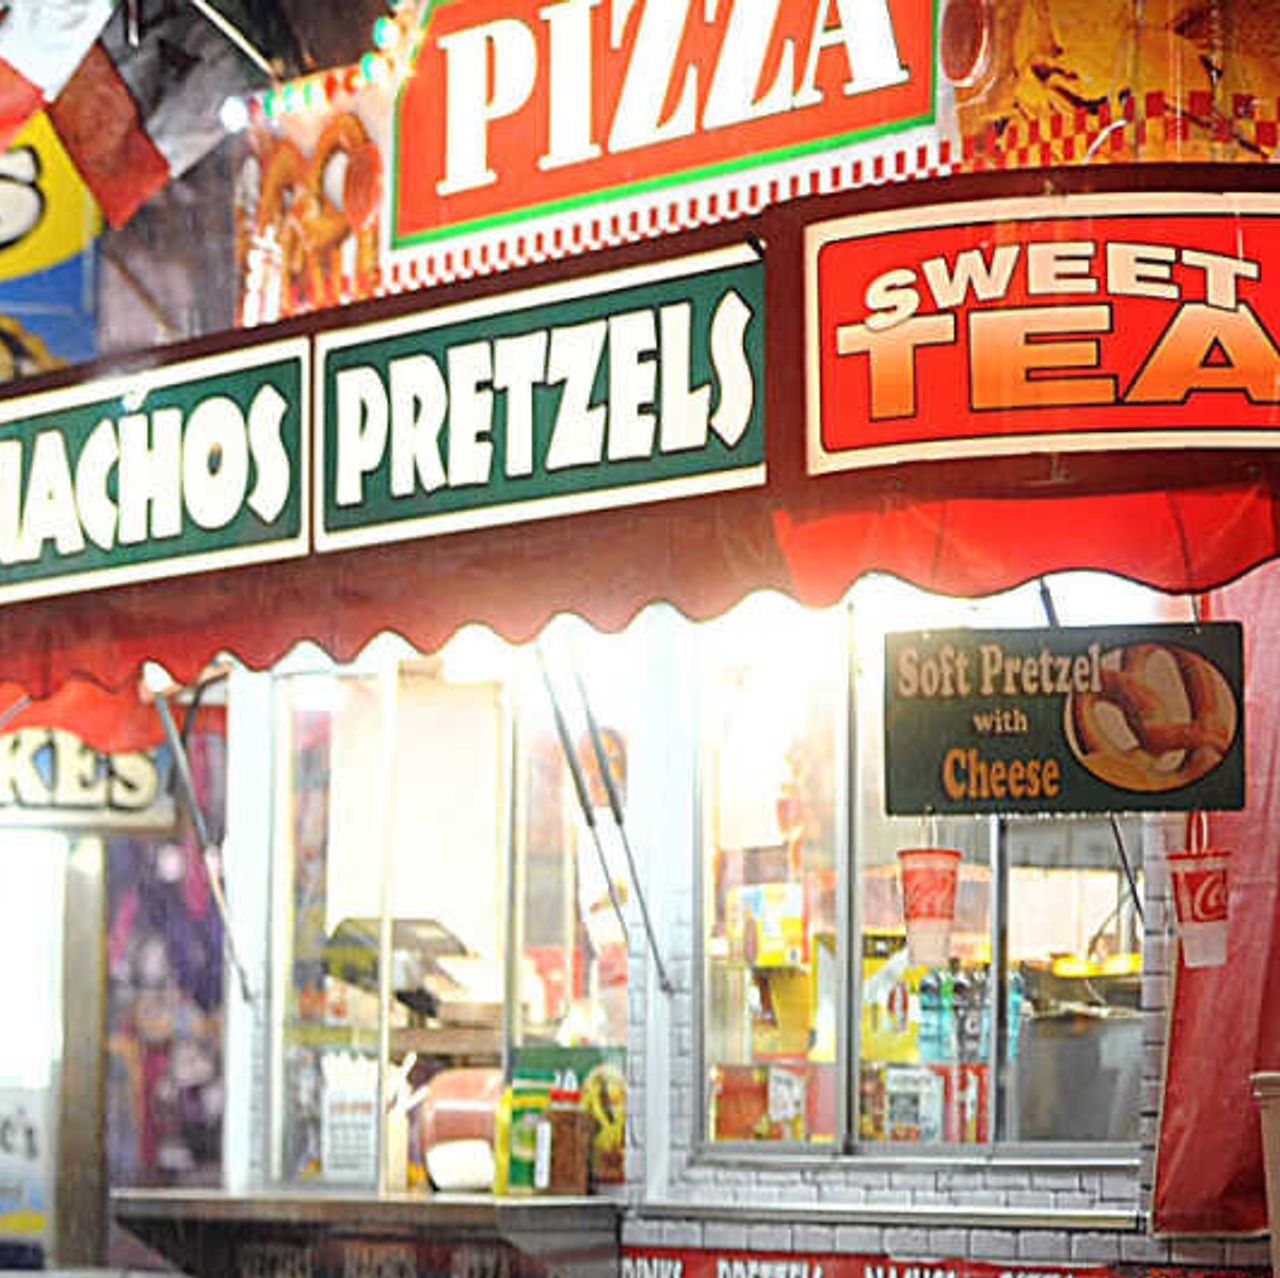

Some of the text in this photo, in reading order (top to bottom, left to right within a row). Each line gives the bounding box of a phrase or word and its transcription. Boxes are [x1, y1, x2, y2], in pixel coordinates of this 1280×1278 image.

[434, 0, 910, 198] PIZZA
[862, 240, 1261, 333] SWEET
[333, 288, 755, 507] PRETZELS
[835, 300, 1280, 422] TEA
[897, 642, 1104, 699] Soft Pretzel
[972, 707, 1030, 735] with
[942, 747, 1061, 800] Cheese
